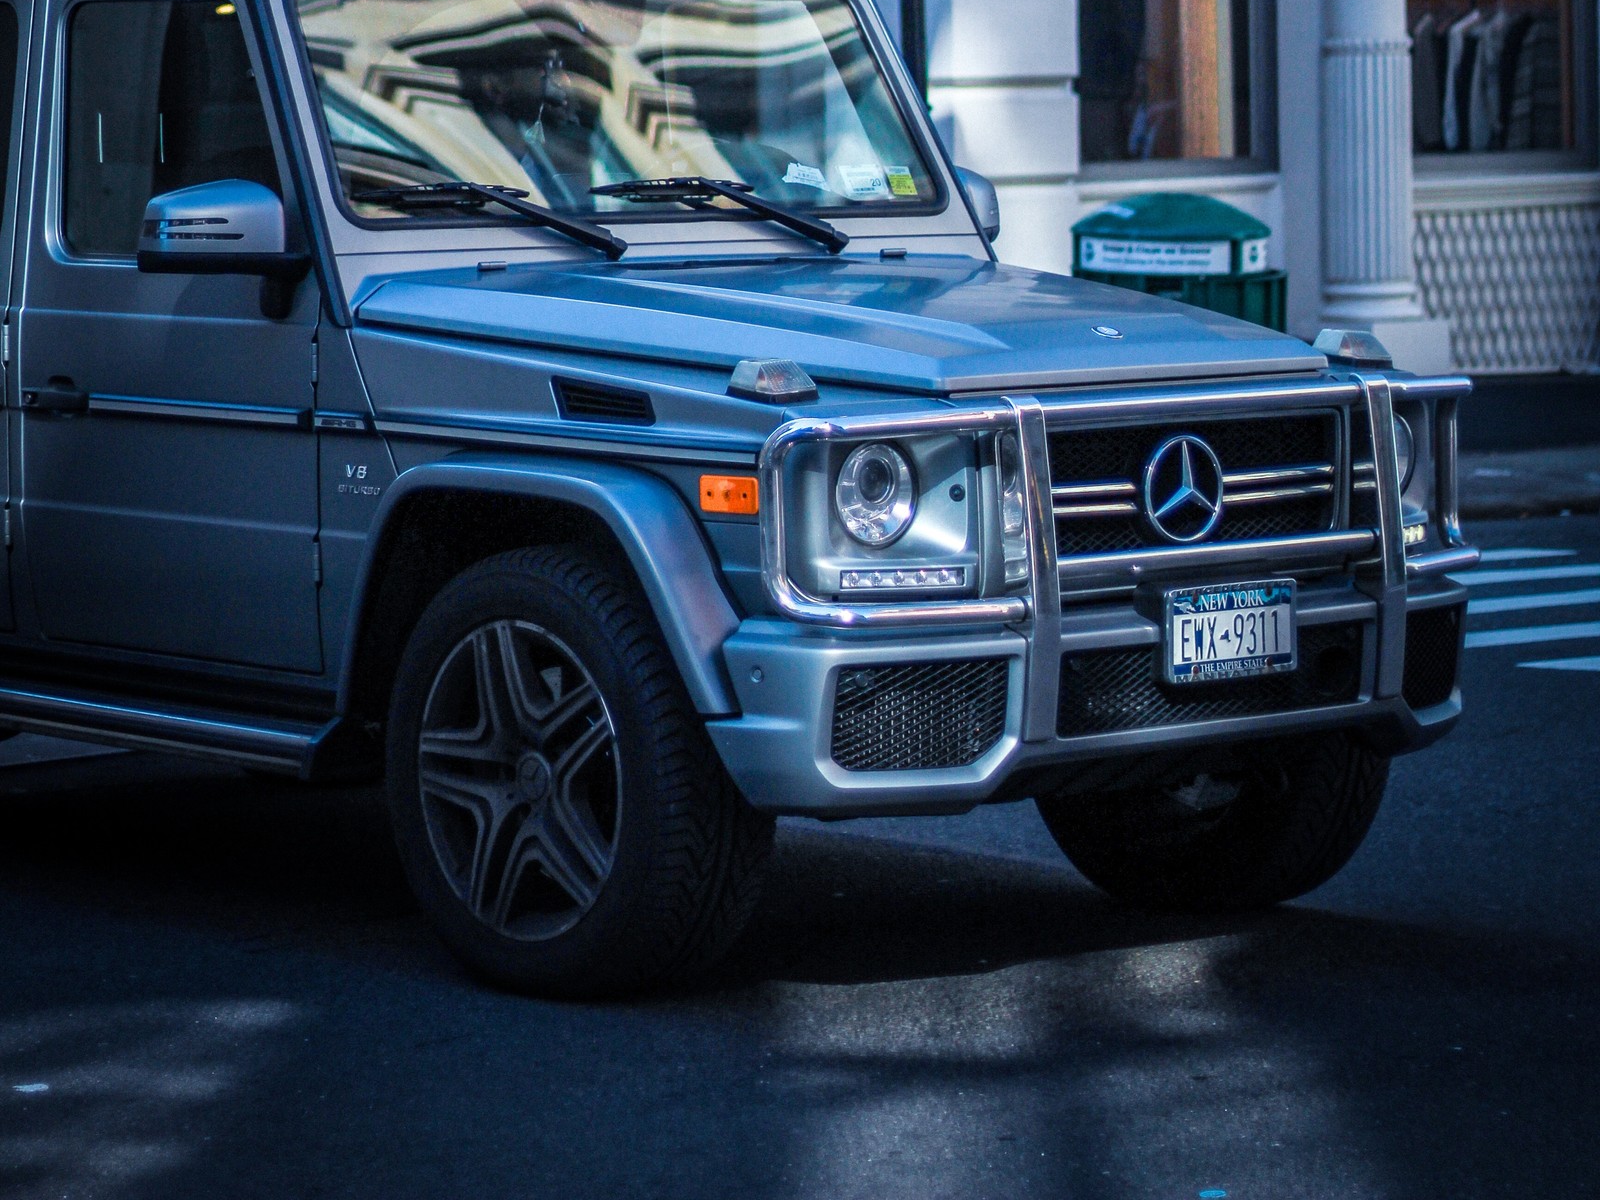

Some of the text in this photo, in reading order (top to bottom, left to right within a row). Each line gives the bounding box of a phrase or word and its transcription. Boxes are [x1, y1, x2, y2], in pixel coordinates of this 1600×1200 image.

[346, 464, 367, 479] V8
[338, 483, 381, 496] BITURBO
[1200, 588, 1264, 611] NEW YORK
[1181, 609, 1279, 662] EWX 9311
[1200, 657, 1265, 673] THE EMPIRE STATE
